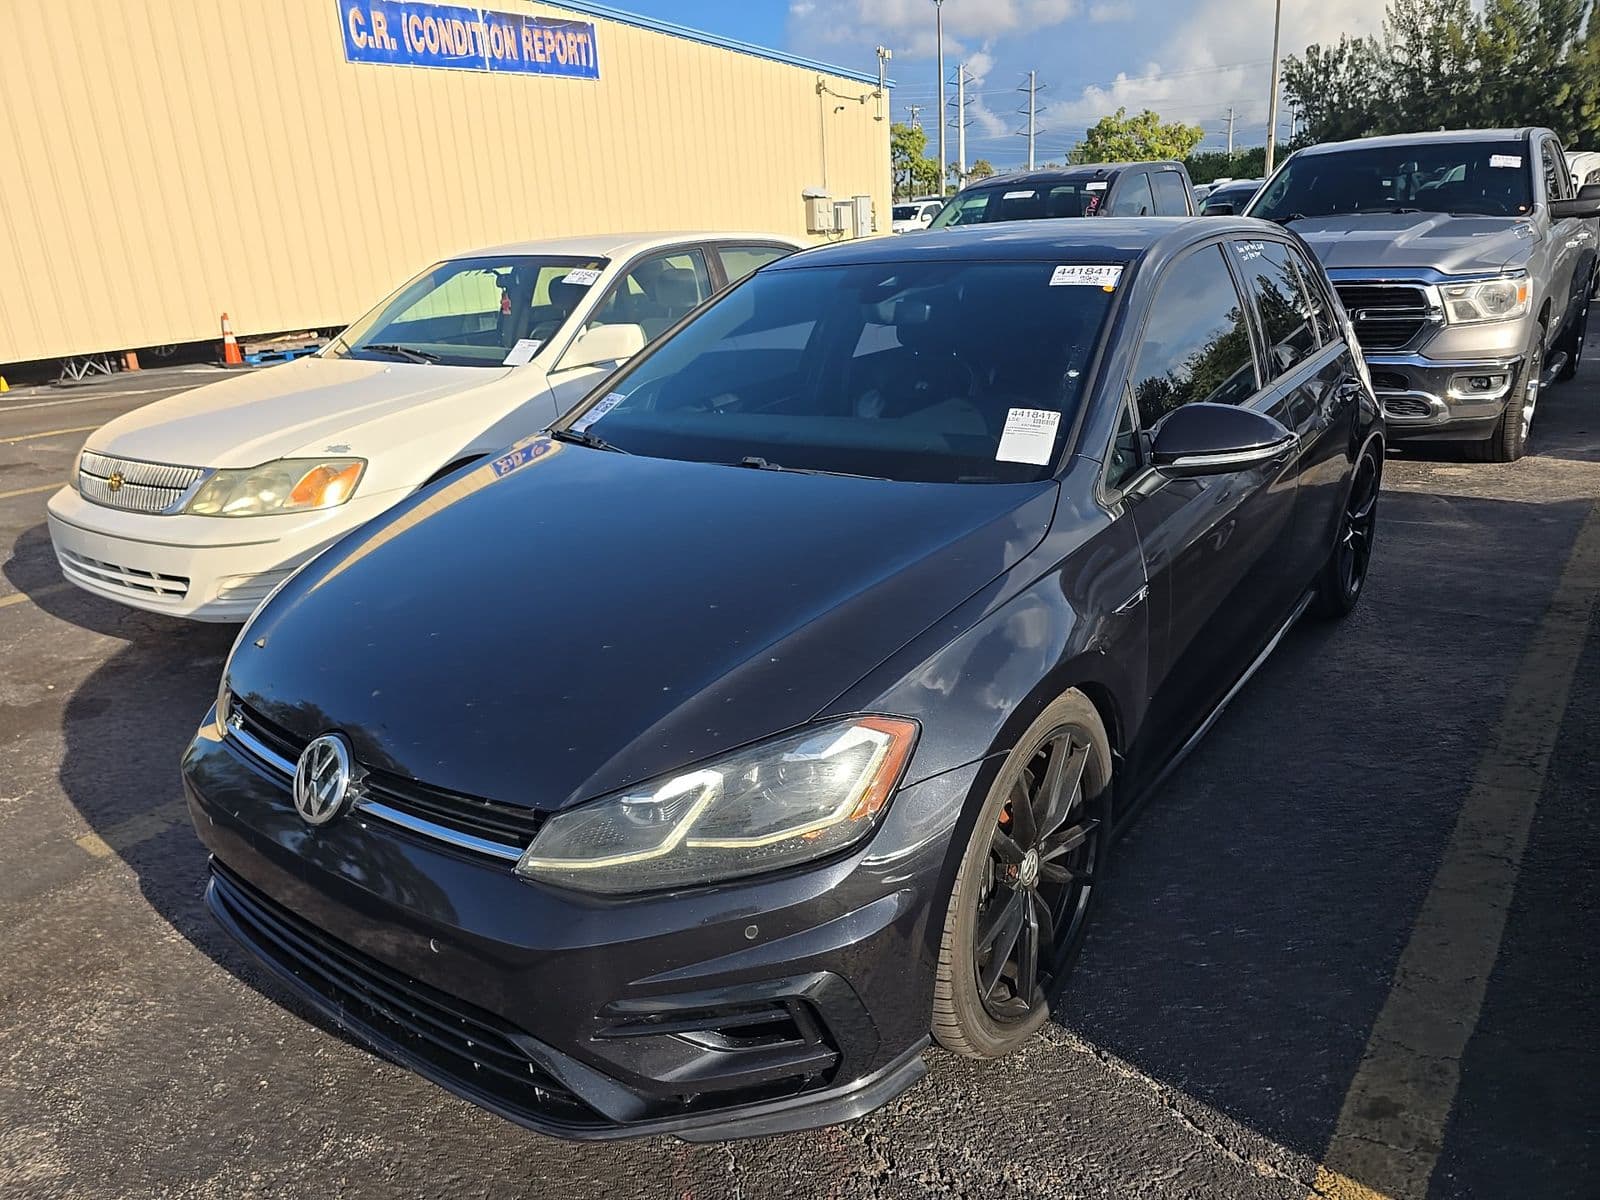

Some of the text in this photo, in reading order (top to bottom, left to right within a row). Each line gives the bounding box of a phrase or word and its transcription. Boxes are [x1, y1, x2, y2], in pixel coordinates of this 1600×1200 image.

[348, 7, 594, 67] C.R. (CONDITION REPORT)
[1057, 267, 1121, 275] 4418417
[1010, 410, 1060, 420] 4418417
